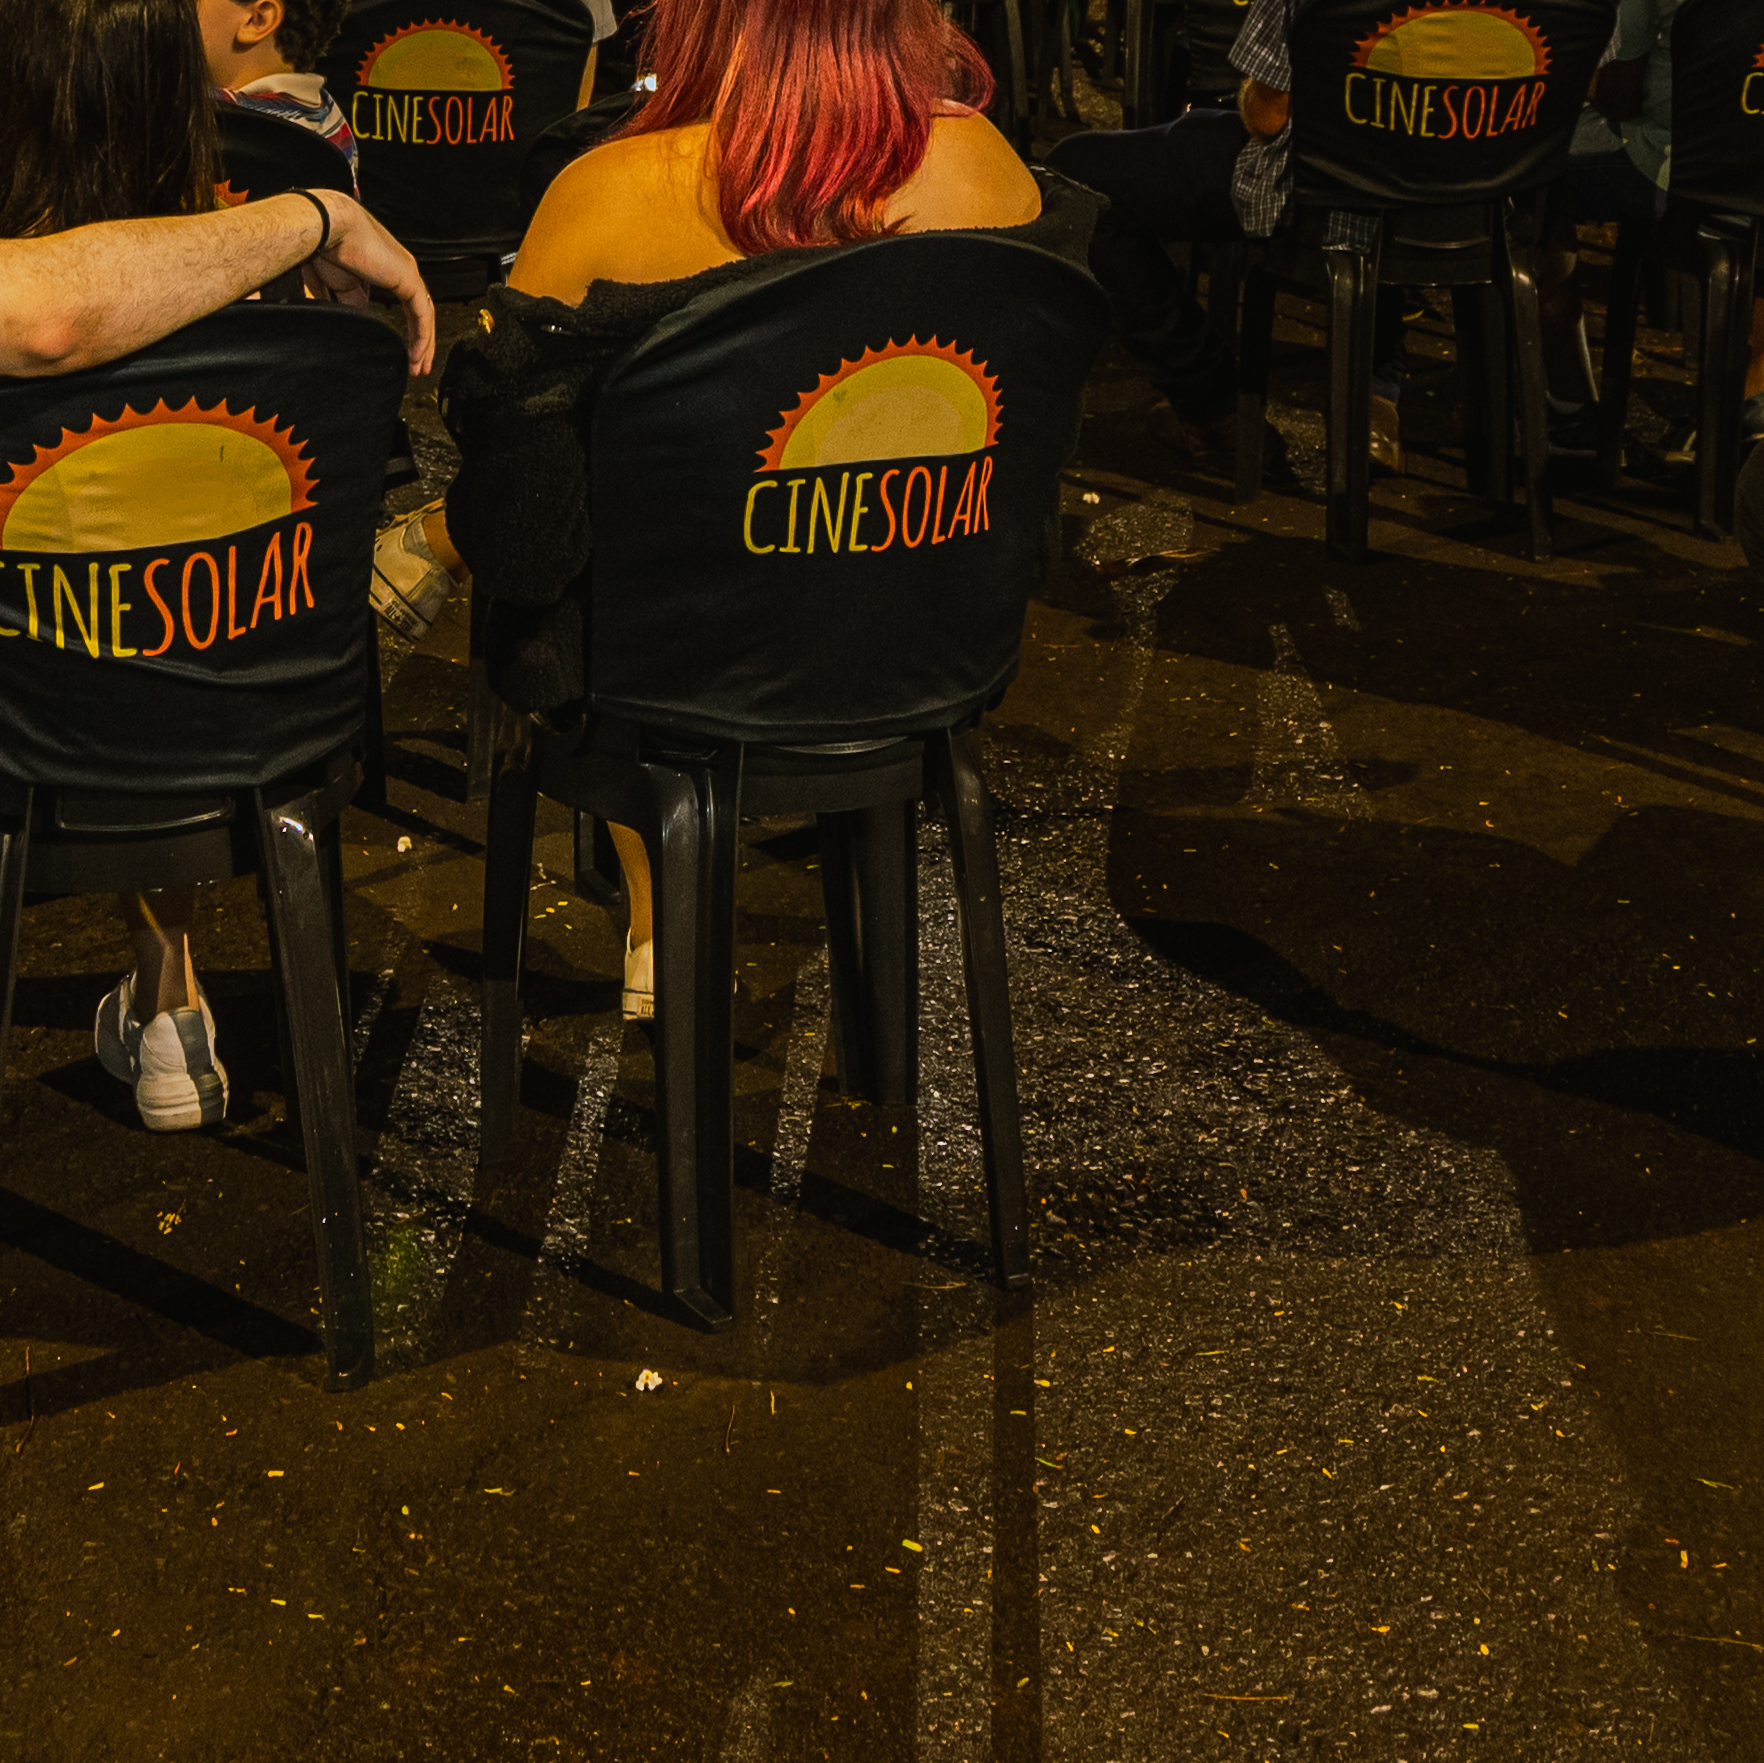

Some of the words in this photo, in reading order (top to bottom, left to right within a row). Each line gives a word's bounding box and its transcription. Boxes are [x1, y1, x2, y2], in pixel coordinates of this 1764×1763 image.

[351, 90, 515, 145] CINESOLAR
[1344, 72, 1546, 140] CINESOLAR
[743, 455, 993, 555] CINESOLAR
